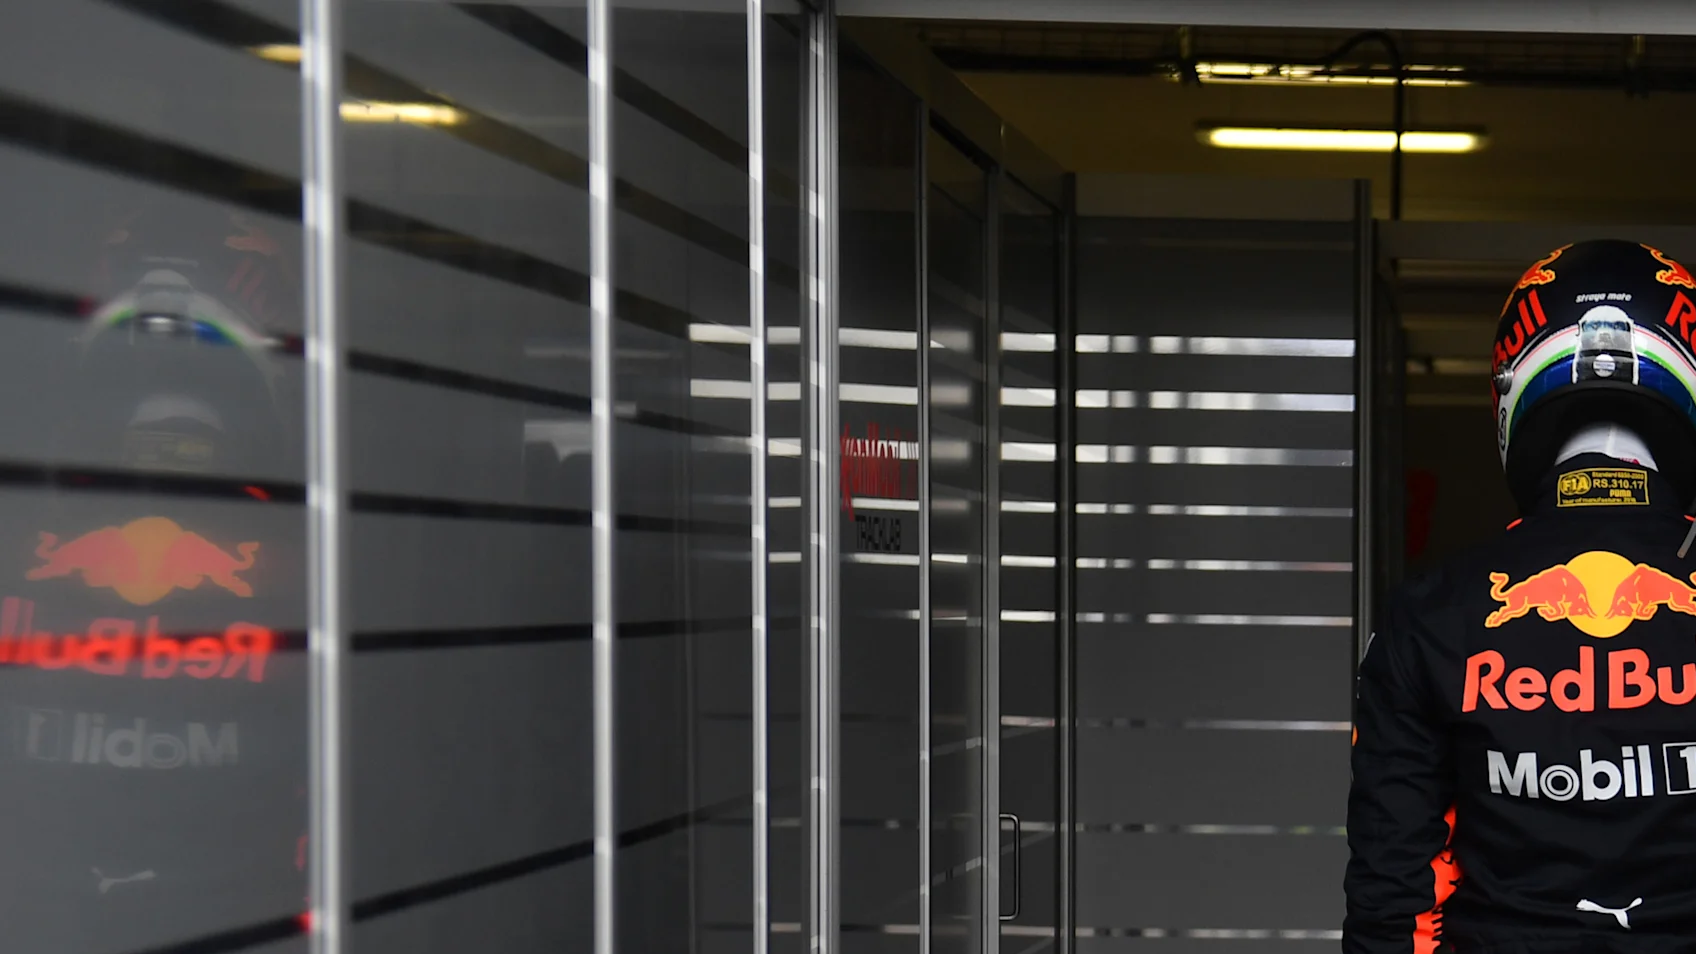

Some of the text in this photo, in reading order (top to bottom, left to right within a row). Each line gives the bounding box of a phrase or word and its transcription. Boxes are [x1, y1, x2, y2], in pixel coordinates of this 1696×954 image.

[1562, 476, 1589, 491] FIA
[1593, 479, 1644, 490] RS.310.17
[1462, 645, 1594, 712] Red
[1487, 744, 1654, 801] Mobil
